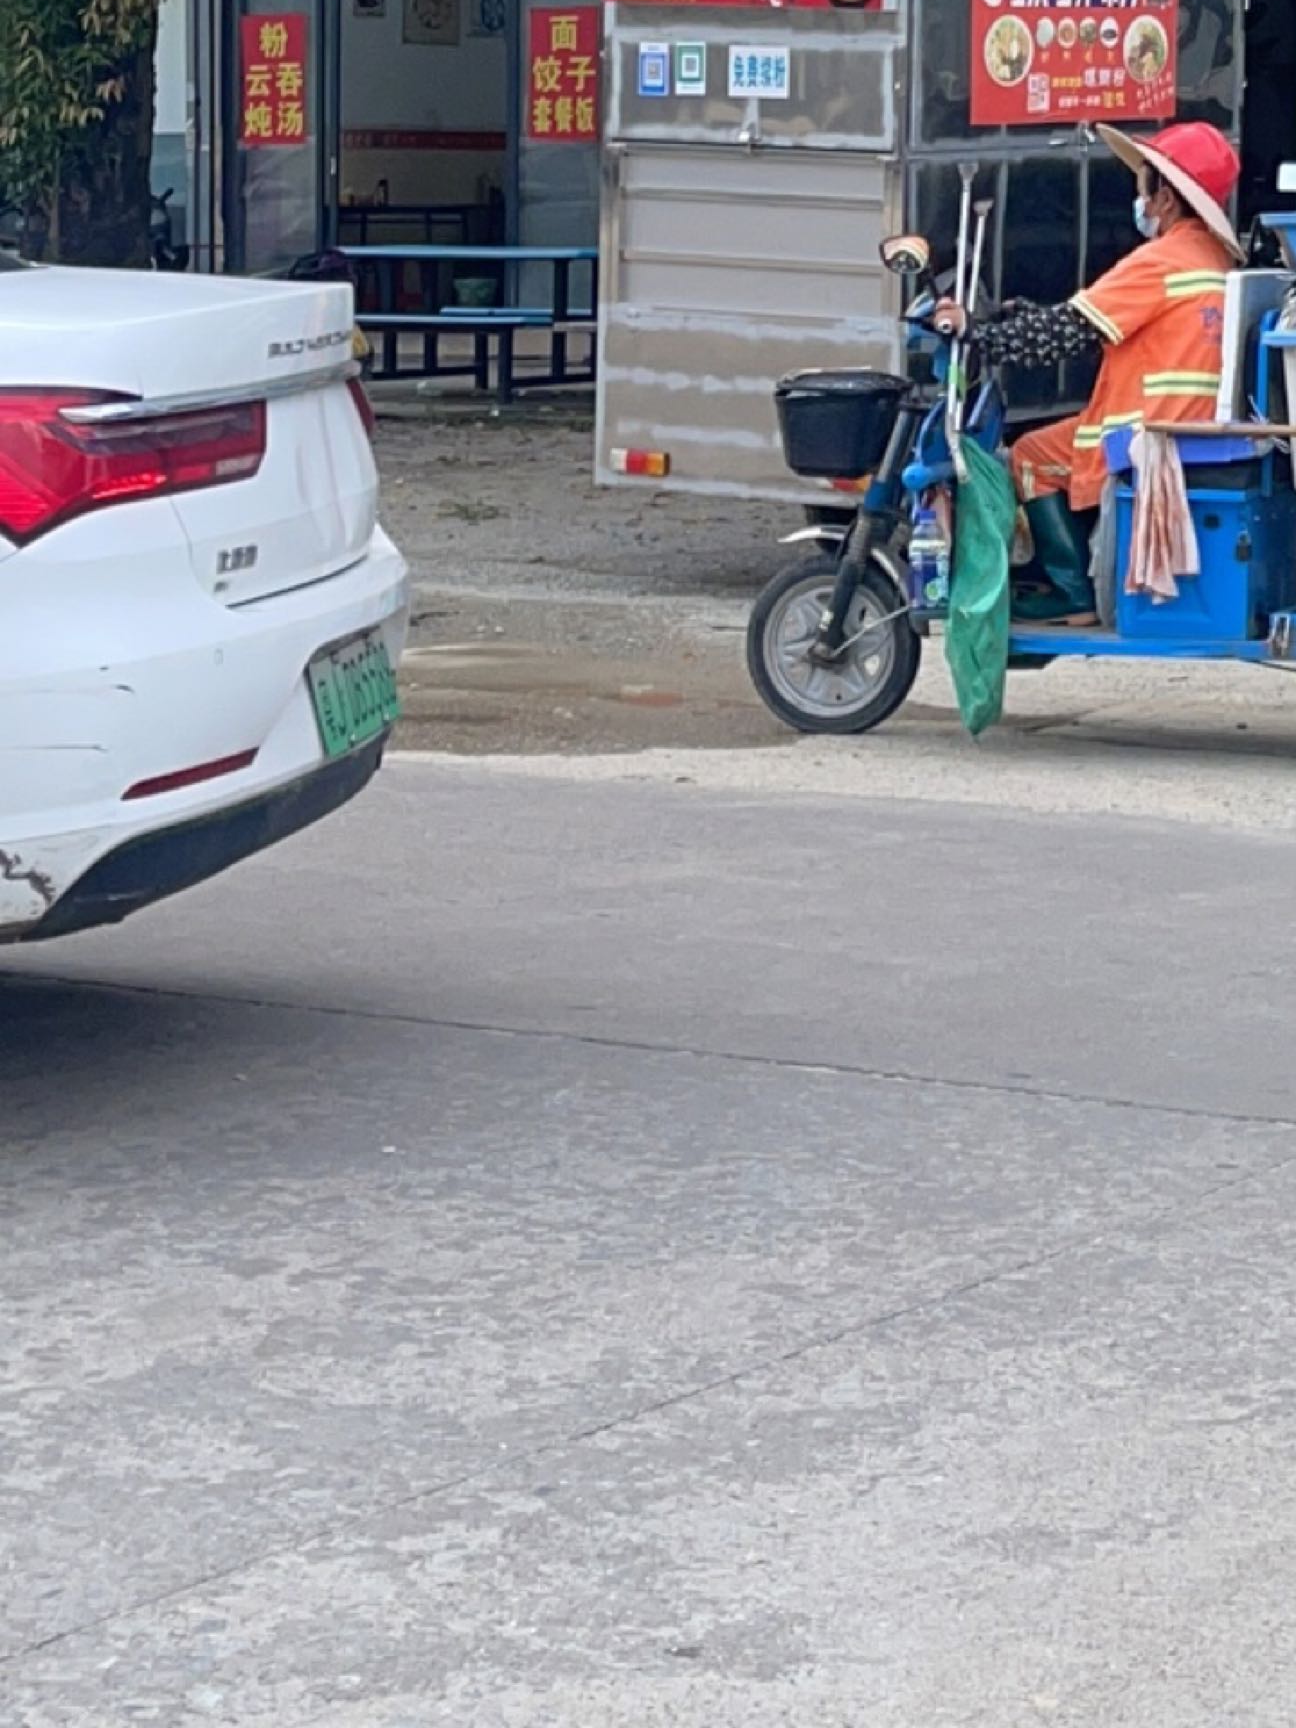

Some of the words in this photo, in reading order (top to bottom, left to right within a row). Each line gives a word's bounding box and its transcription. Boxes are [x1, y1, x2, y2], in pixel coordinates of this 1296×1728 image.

[259, 21, 288, 59] 粉
[550, 15, 580, 51] 面
[245, 62, 303, 97] 云吞
[532, 55, 596, 93] 饺子
[244, 101, 303, 138] 炖汤
[533, 96, 595, 133] 套餐饭
